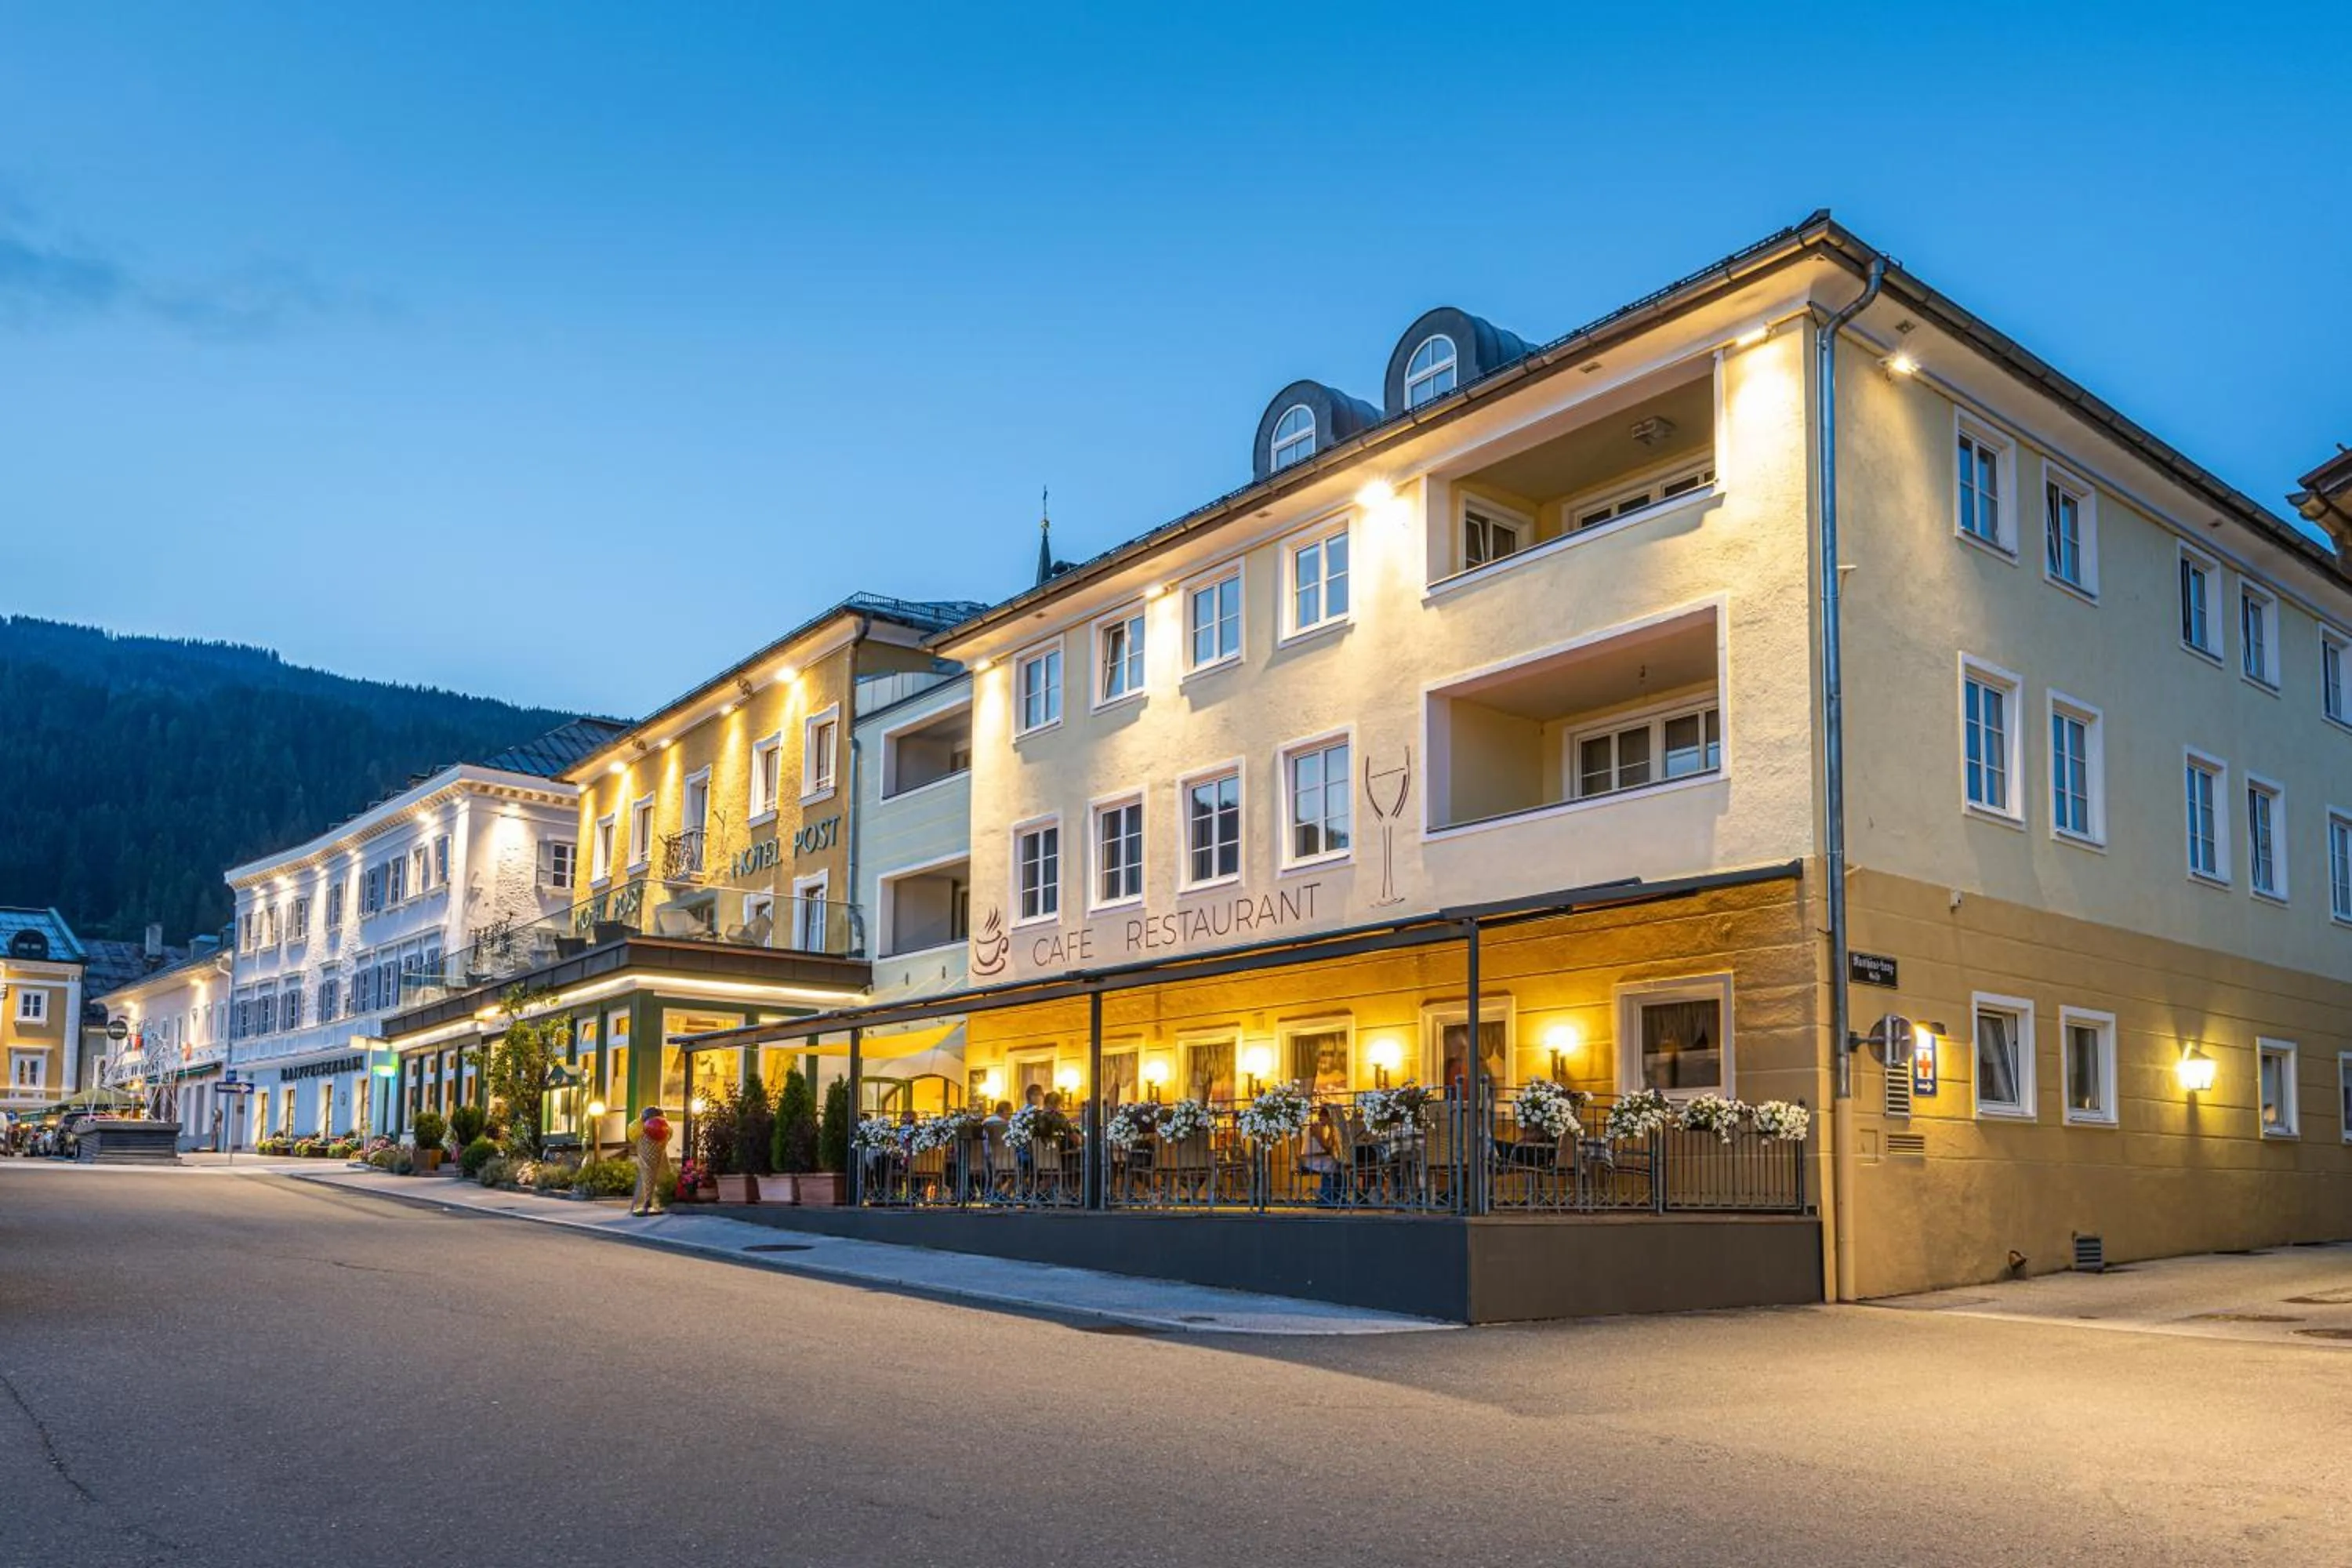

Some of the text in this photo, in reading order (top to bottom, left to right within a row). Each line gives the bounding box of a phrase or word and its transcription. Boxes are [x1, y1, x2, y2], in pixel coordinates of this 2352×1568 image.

[730, 815, 841, 879] HOTEL POST
[1033, 883, 1321, 966] CAFE RESTAURANT
